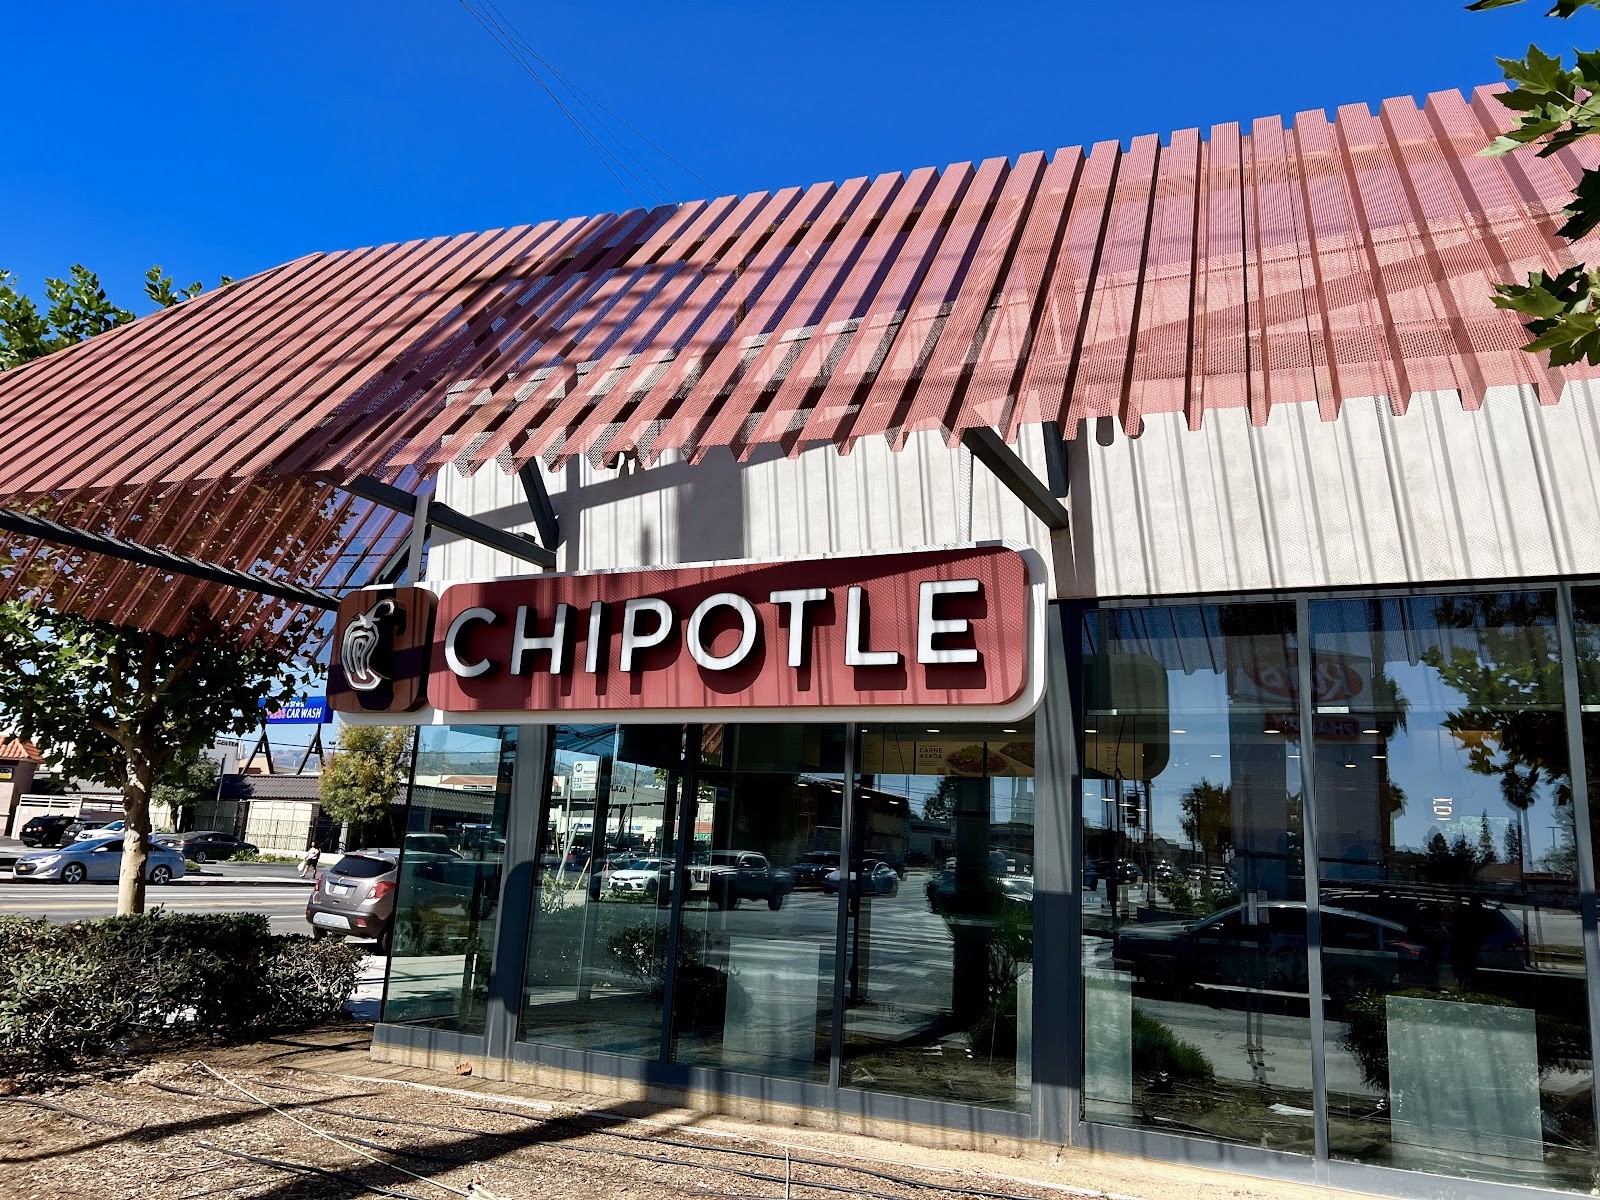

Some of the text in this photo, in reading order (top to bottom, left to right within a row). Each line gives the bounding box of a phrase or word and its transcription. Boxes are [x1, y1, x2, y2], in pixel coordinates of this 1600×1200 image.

[443, 578, 980, 678] CHIPOTLE
[286, 707, 300, 719] CAR
[301, 707, 322, 719] WASH
